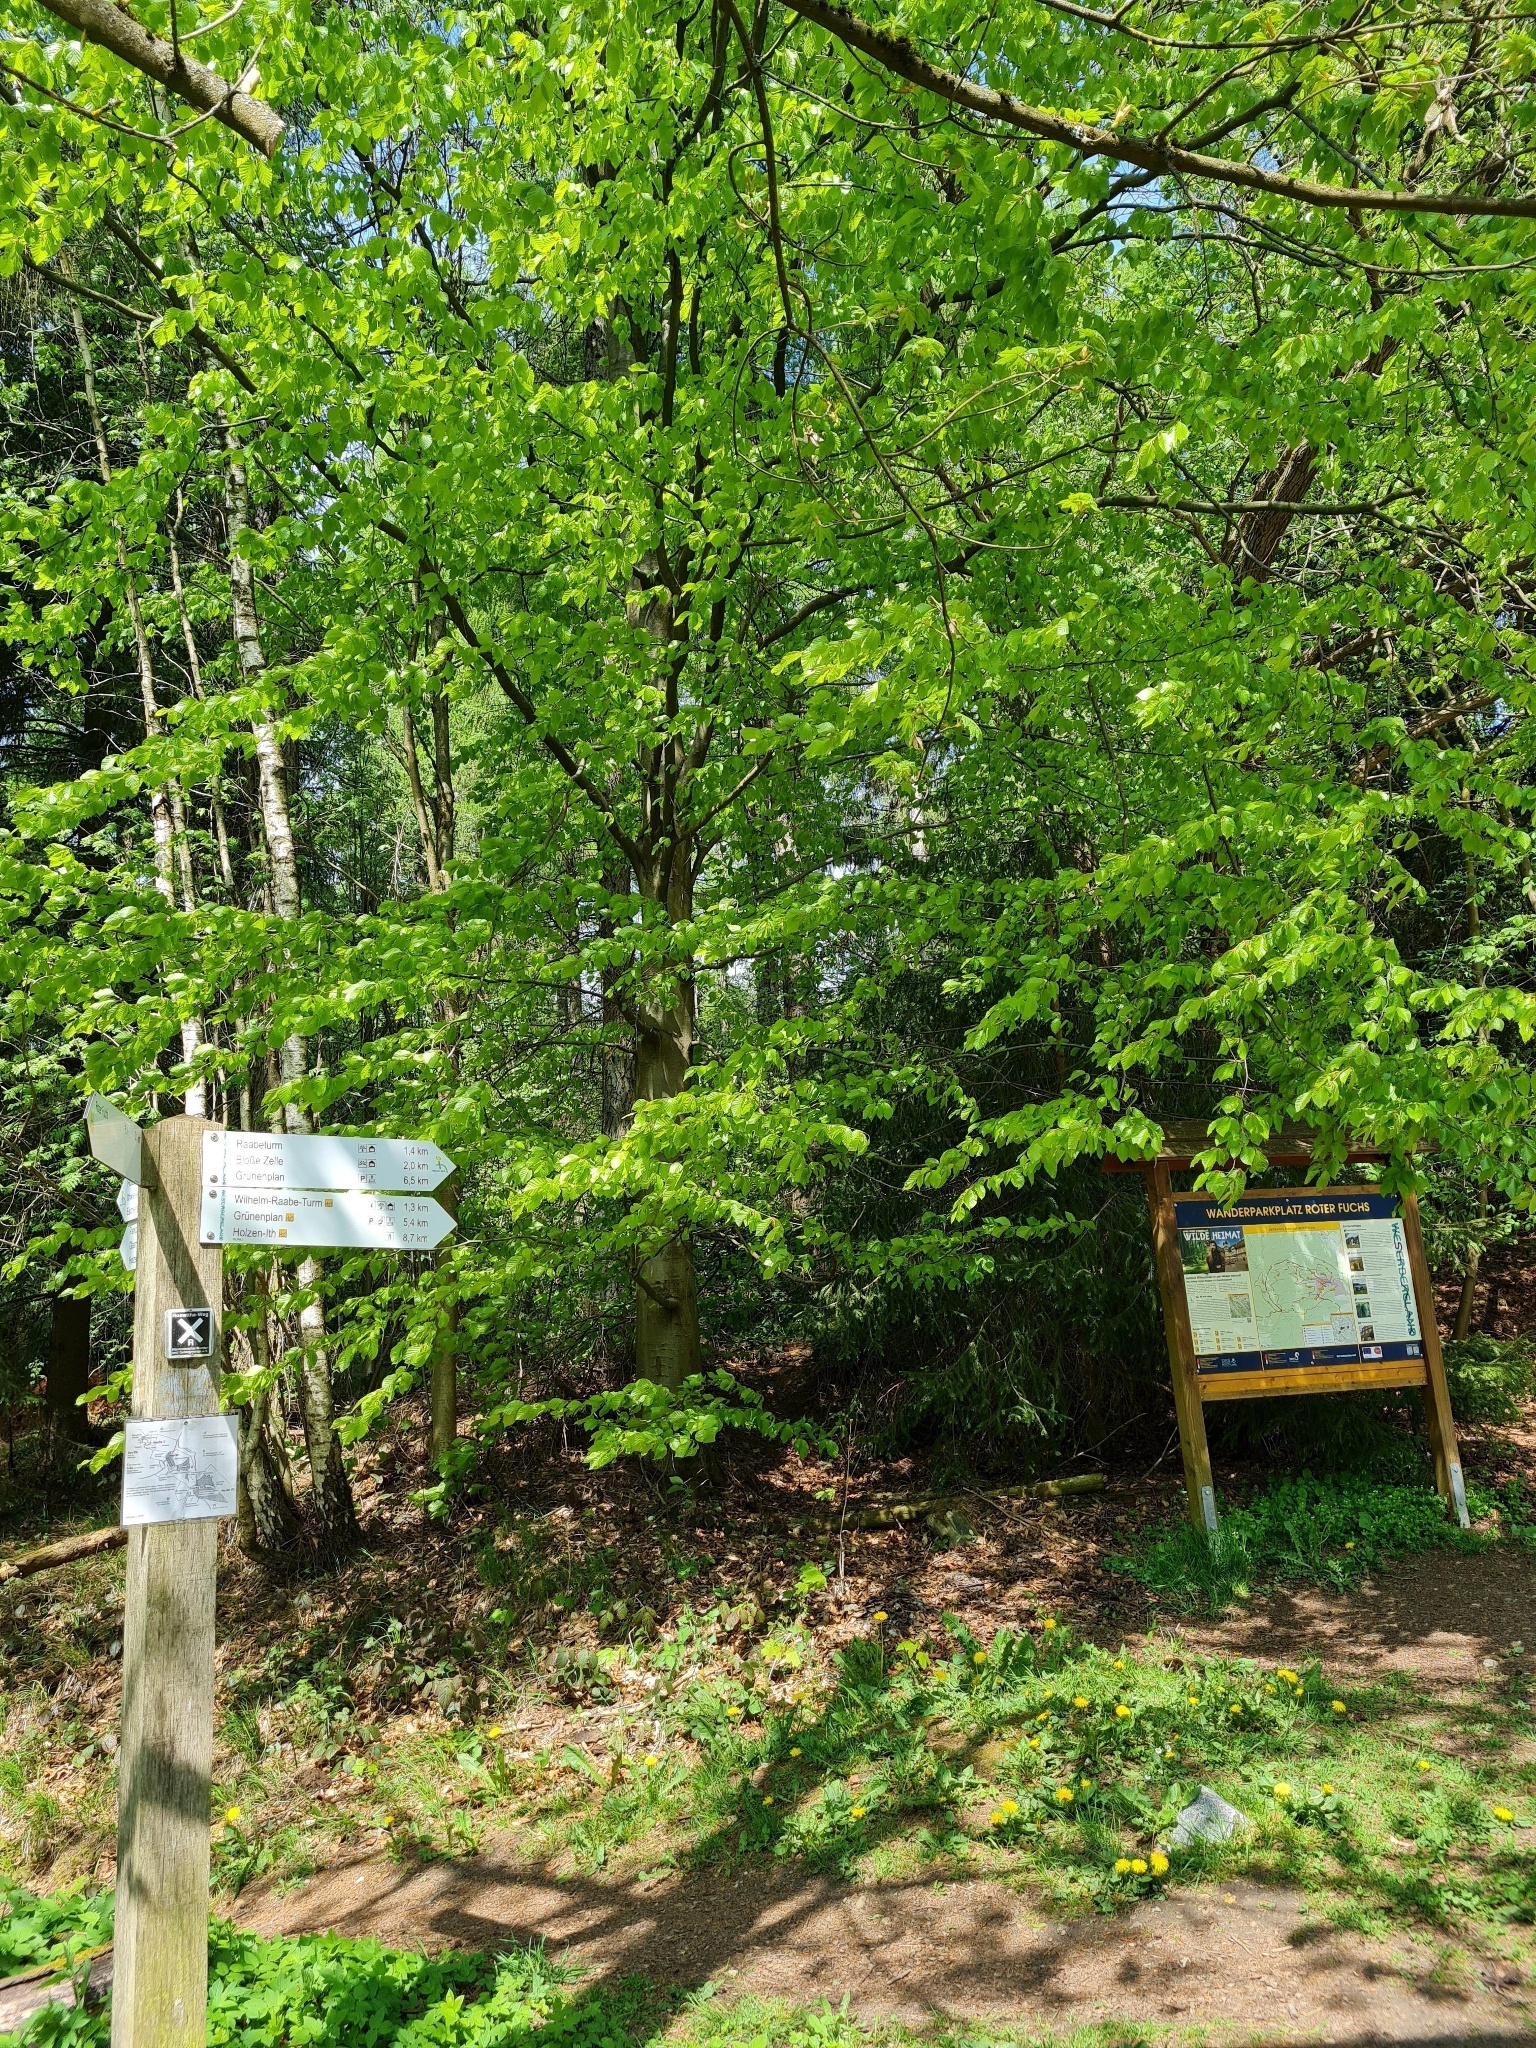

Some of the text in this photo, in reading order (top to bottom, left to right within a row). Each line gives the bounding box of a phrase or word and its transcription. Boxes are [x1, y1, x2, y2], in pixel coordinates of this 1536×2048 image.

[236, 1140, 283, 1150] Raabeturm
[403, 1146, 429, 1156] 1,4 km
[263, 1155, 284, 1166] Zelle
[403, 1161, 416, 1171] 2,0
[417, 1162, 429, 1171] km
[403, 1177, 429, 1186] 6,5 km
[234, 1194, 323, 1208] Wilhelm-Raabe-Turm
[403, 1202, 429, 1213] 1,3 km
[1205, 1201, 1370, 1219] WANDERPARKPLATZ ROTER FUCHS
[233, 1210, 284, 1223] Grünenplan
[403, 1218, 429, 1228] 5,4 km
[232, 1227, 277, 1239] Holzen-Ith
[402, 1233, 428, 1243] 8,7 km
[1183, 1230, 1241, 1241] WILDE HEIMAT
[187, 1338, 194, 1346] R
